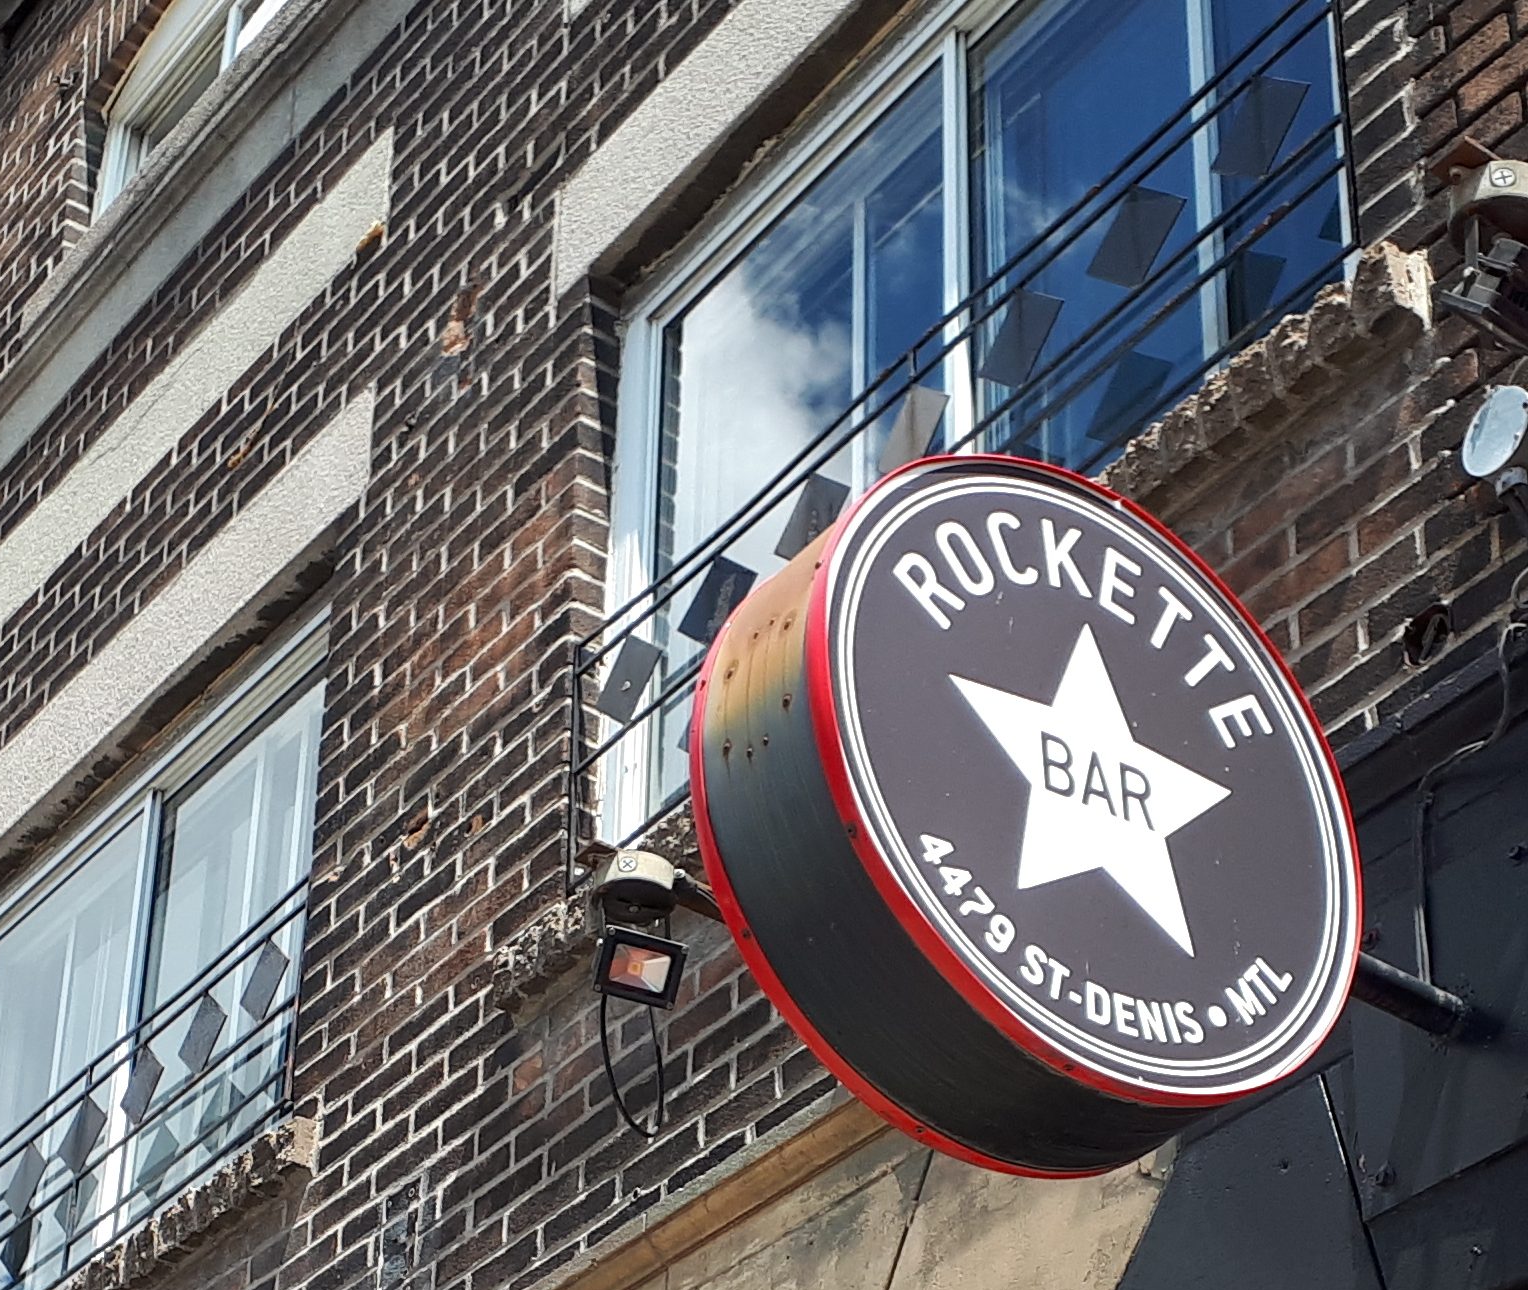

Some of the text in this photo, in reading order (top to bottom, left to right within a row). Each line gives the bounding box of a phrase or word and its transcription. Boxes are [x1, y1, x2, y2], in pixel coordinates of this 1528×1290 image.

[893, 510, 1273, 749] ROCKETTE
[1040, 731, 1156, 832] BAR
[919, 833, 1294, 1045] 4479 ST-DENIS MTL
